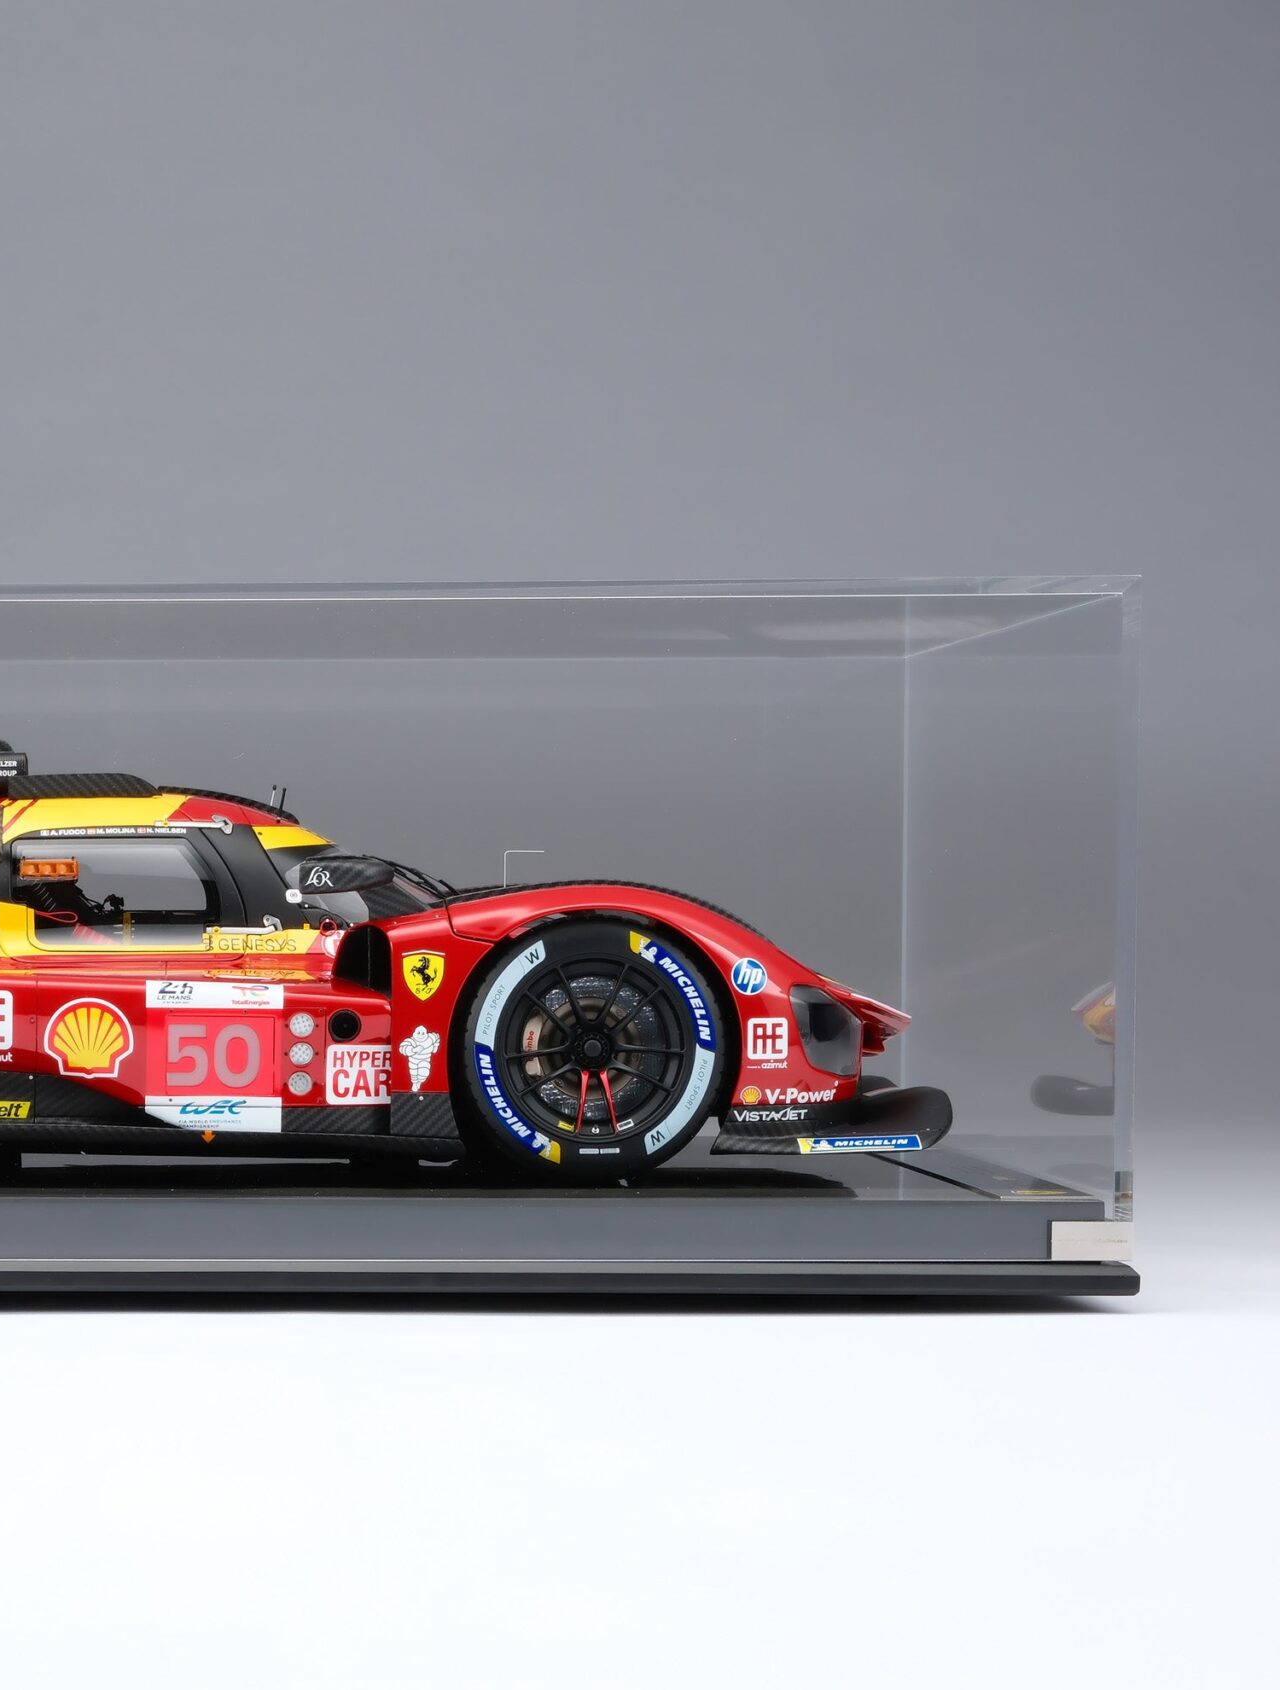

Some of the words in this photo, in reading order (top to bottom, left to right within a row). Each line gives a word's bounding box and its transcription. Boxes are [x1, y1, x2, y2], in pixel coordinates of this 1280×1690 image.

[218, 938, 297, 952] GENESYS
[737, 961, 762, 993] hp
[482, 1012, 492, 1036] PILOT
[492, 984, 506, 1010] SPORT
[658, 956, 711, 1041] MICHELIN
[166, 1023, 261, 1088] 50
[332, 1051, 391, 1068] HYPER
[761, 1060, 788, 1069] azimut
[696, 1059, 707, 1082] PILOT
[332, 1069, 391, 1098] CAR
[479, 1053, 531, 1138] MICHELIN
[179, 1100, 247, 1115] WEC
[685, 1085, 701, 1110] SPORT
[765, 1087, 836, 1105] V-Power
[835, 1139, 908, 1147] MICHELIN
